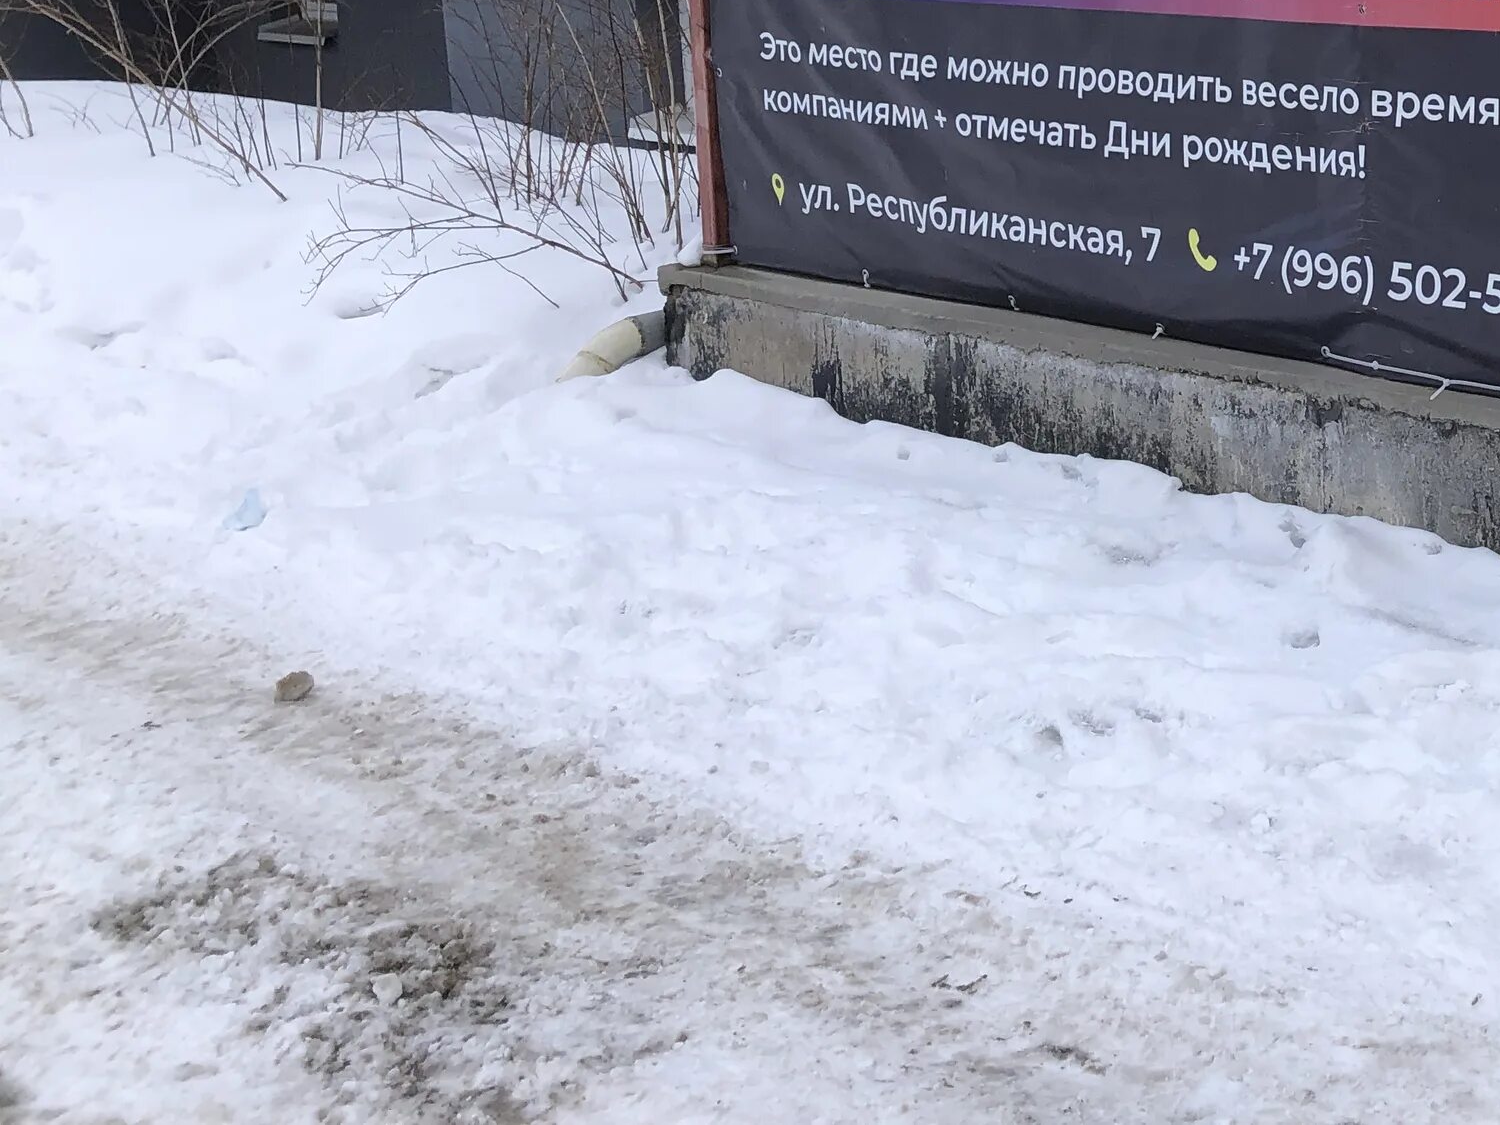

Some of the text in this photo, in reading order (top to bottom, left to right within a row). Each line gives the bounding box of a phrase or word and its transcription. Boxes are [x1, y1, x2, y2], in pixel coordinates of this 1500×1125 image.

[759, 32, 801, 63] Это
[808, 43, 882, 73] место
[889, 51, 937, 81] где
[946, 56, 1049, 89] можно
[1058, 65, 1233, 103] проводить
[1242, 79, 1360, 115] весело
[1371, 91, 1500, 127] время
[763, 86, 1367, 179] компаниями + отмечать Дни рождения!
[799, 182, 1162, 266] ул. Республиканская, 7
[1233, 242, 1274, 282] +7
[1281, 245, 1374, 305] (996)
